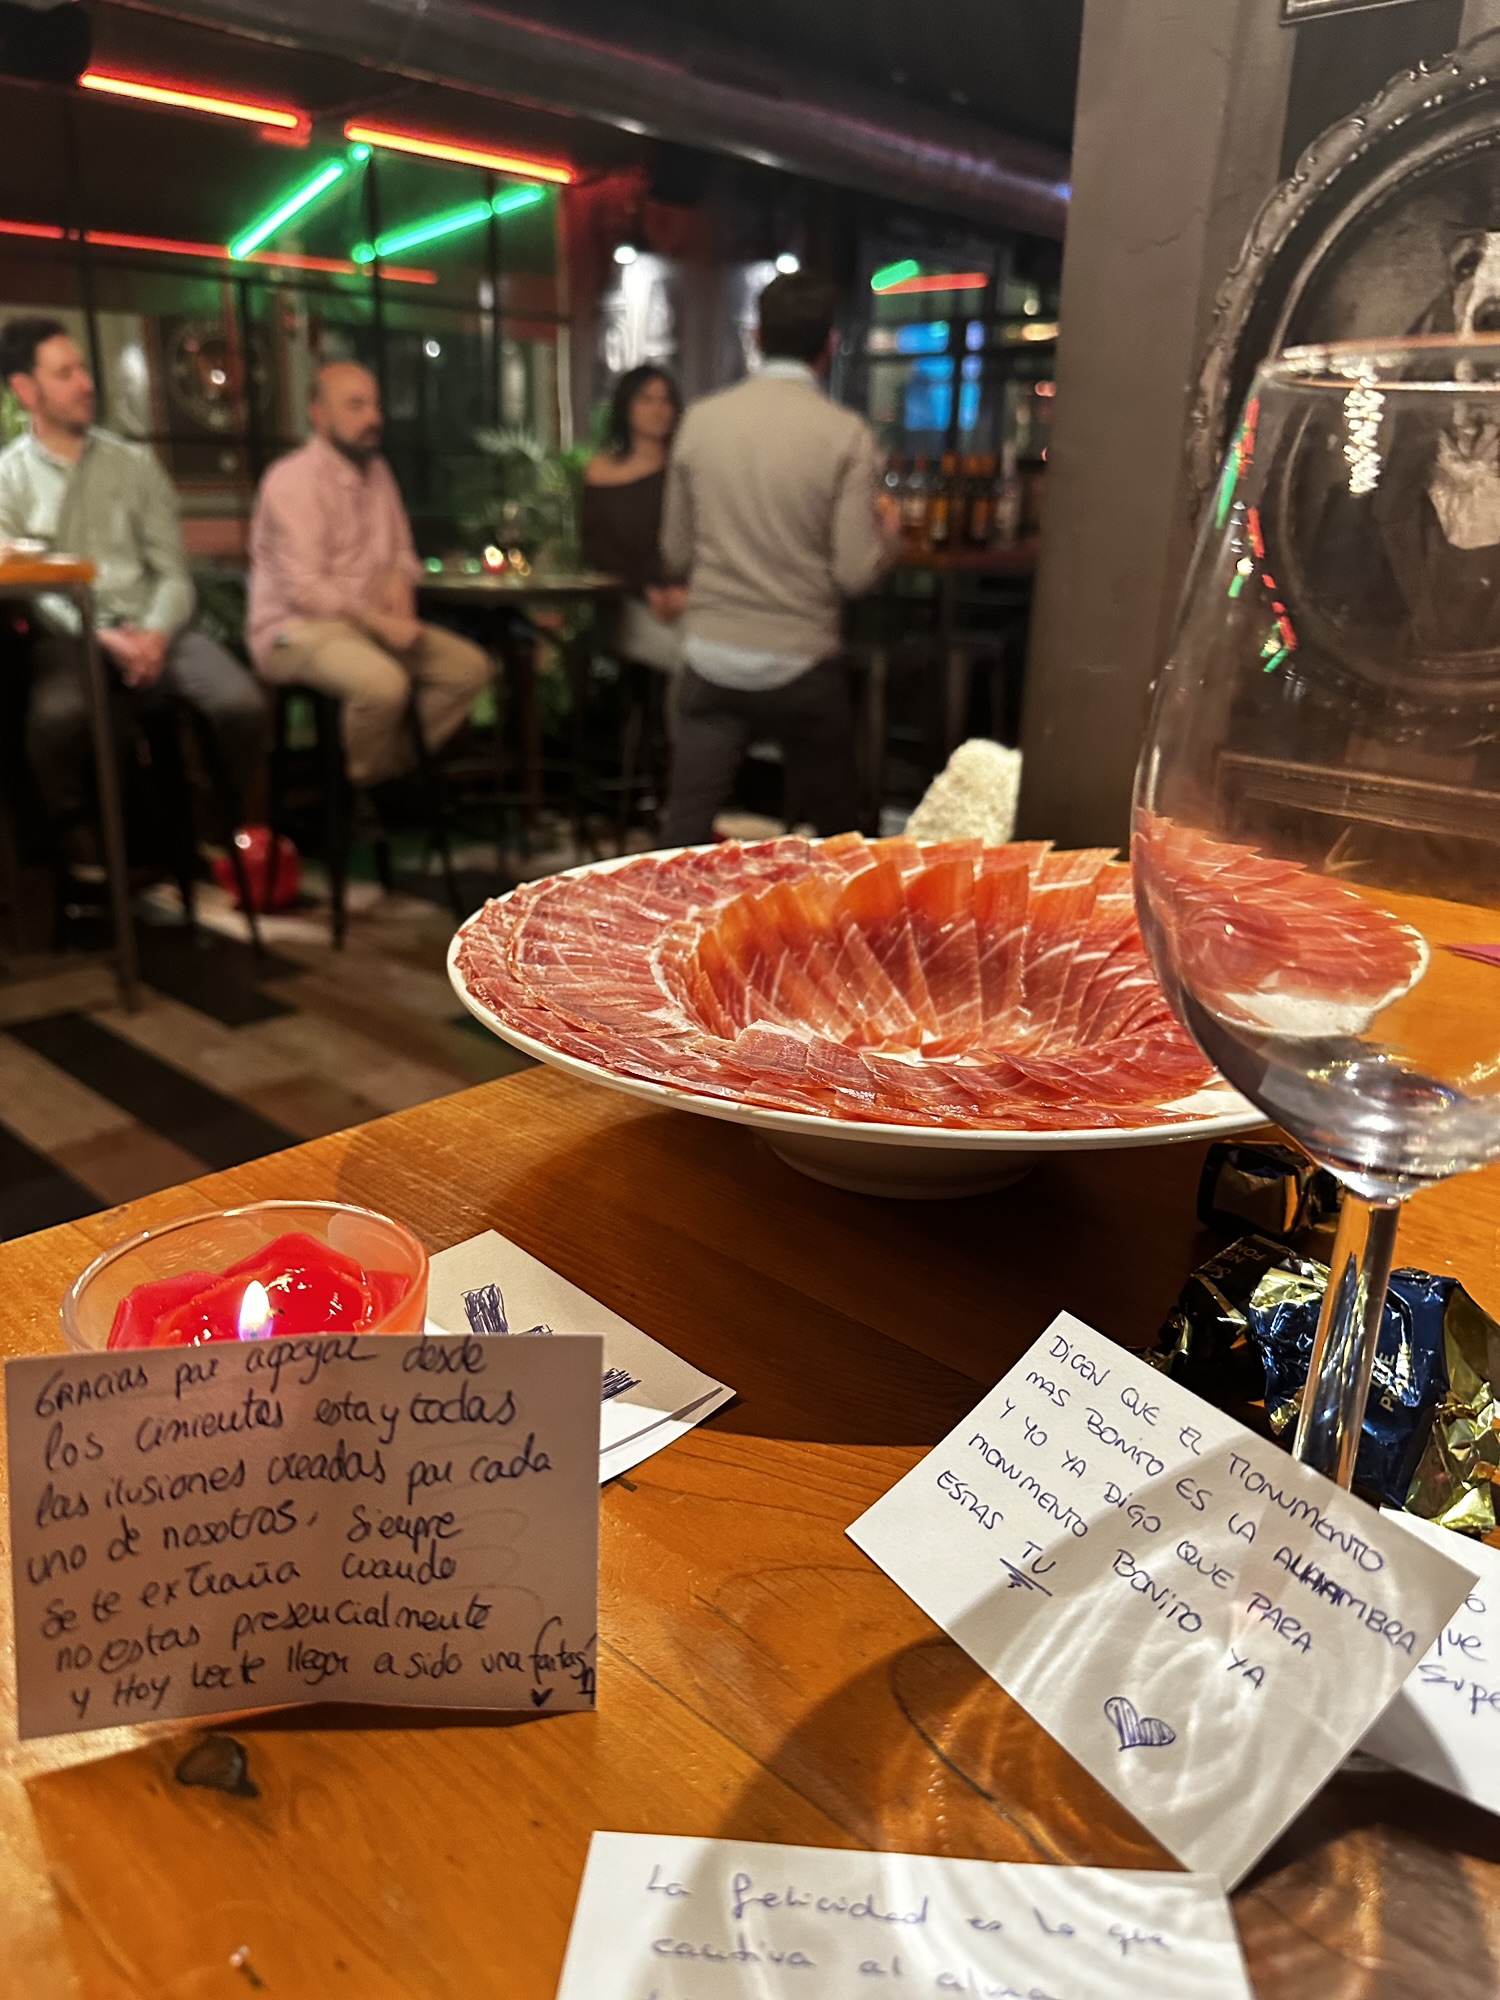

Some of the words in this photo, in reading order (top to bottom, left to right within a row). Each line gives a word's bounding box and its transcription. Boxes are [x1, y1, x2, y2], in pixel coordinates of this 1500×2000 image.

[44, 1420, 104, 1471] los
[410, 1380, 516, 1425] todas
[1025, 1371, 1071, 1407] MAS
[1085, 1407, 1164, 1476] BONITO
[1175, 1478, 1213, 1511] ES
[1228, 1512, 1257, 1544] LA
[36, 1482, 90, 1528] las
[104, 1459, 246, 1510] ilusiones
[408, 1459, 452, 1505] por
[470, 1432, 552, 1484] cada
[936, 1470, 1004, 1530] ESTAS
[1020, 1540, 1056, 1574] TU
[1120, 1387, 1160, 1426] QUE
[1179, 1426, 1202, 1456] EL
[1228, 1452, 1384, 1573] MONUMENTO
[26, 1544, 87, 1584] uno
[108, 1515, 140, 1562] de
[968, 1433, 1089, 1538] MONUMENTO
[1111, 1549, 1202, 1633] BONITO
[1227, 1648, 1265, 1689] YA
[1024, 1416, 1048, 1446] YO
[1060, 1450, 1087, 1478] YA
[1176, 1541, 1234, 1590] QUE
[1247, 1592, 1313, 1654] PARA
[56, 1643, 92, 1672] no
[99, 1624, 200, 1674] estas
[92, 1588, 121, 1624] te
[481, 1650, 524, 1673] una
[646, 1864, 692, 1896] La
[732, 1872, 928, 1924] felicidad
[1107, 1923, 1174, 1957] que
[651, 1931, 816, 1970] cautiva
